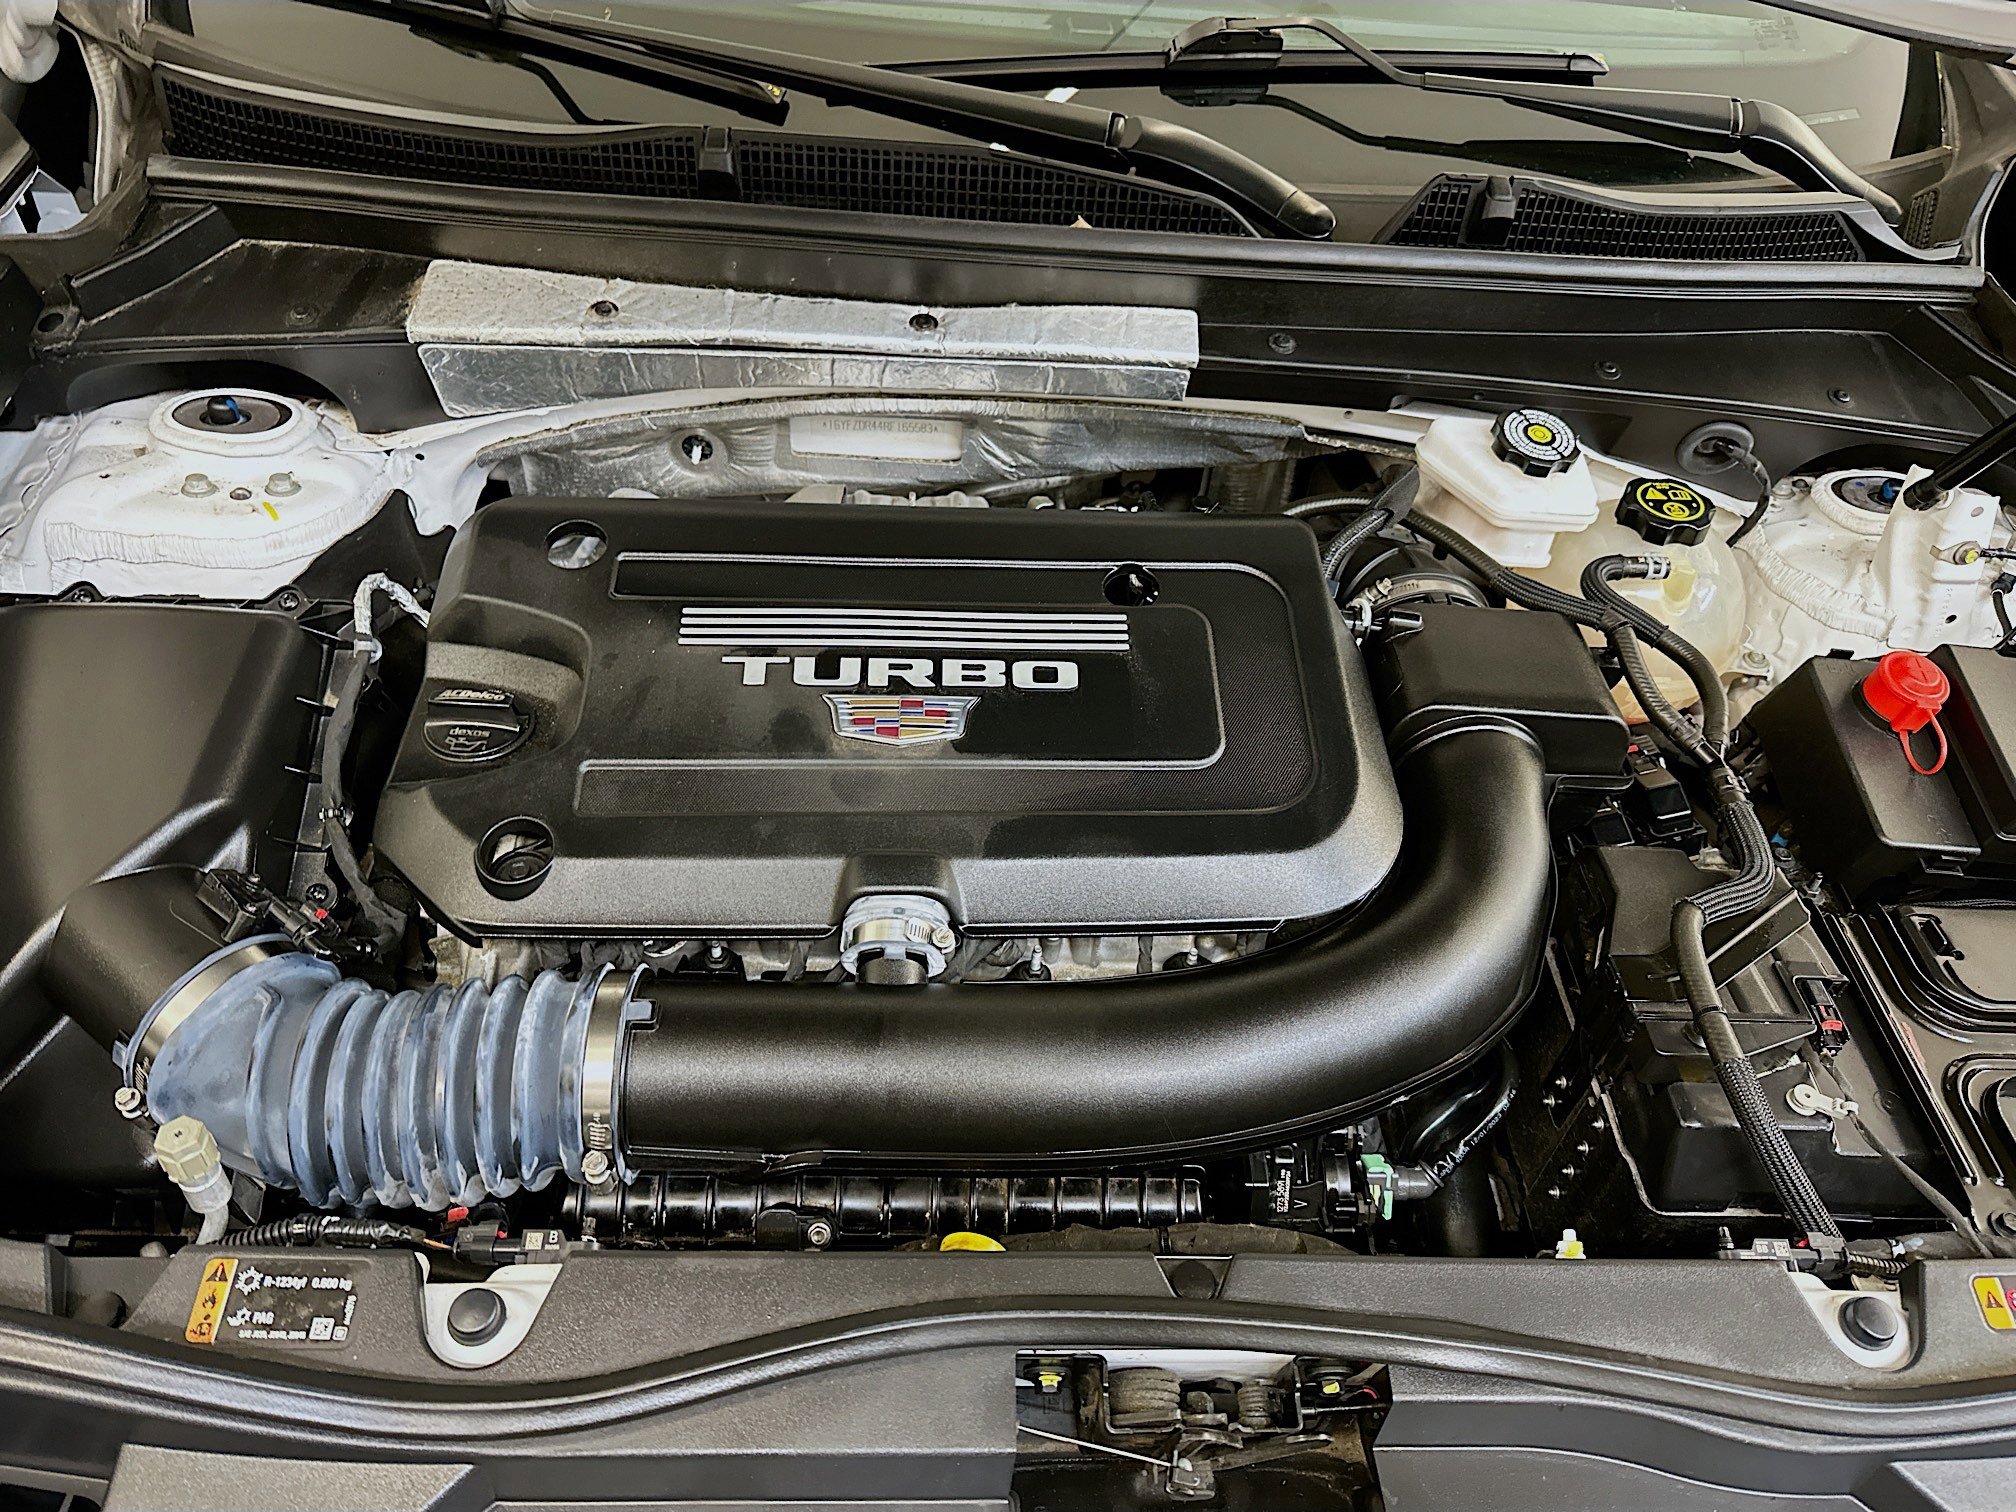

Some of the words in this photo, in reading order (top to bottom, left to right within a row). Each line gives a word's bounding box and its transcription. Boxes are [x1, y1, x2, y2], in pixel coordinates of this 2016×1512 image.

[721, 656, 1079, 690] TURBO
[438, 688, 506, 701] ACDelco
[449, 727, 491, 738] dexos
[548, 1230, 559, 1244] B
[339, 1277, 353, 1292] kg
[252, 1311, 275, 1325] PAG
